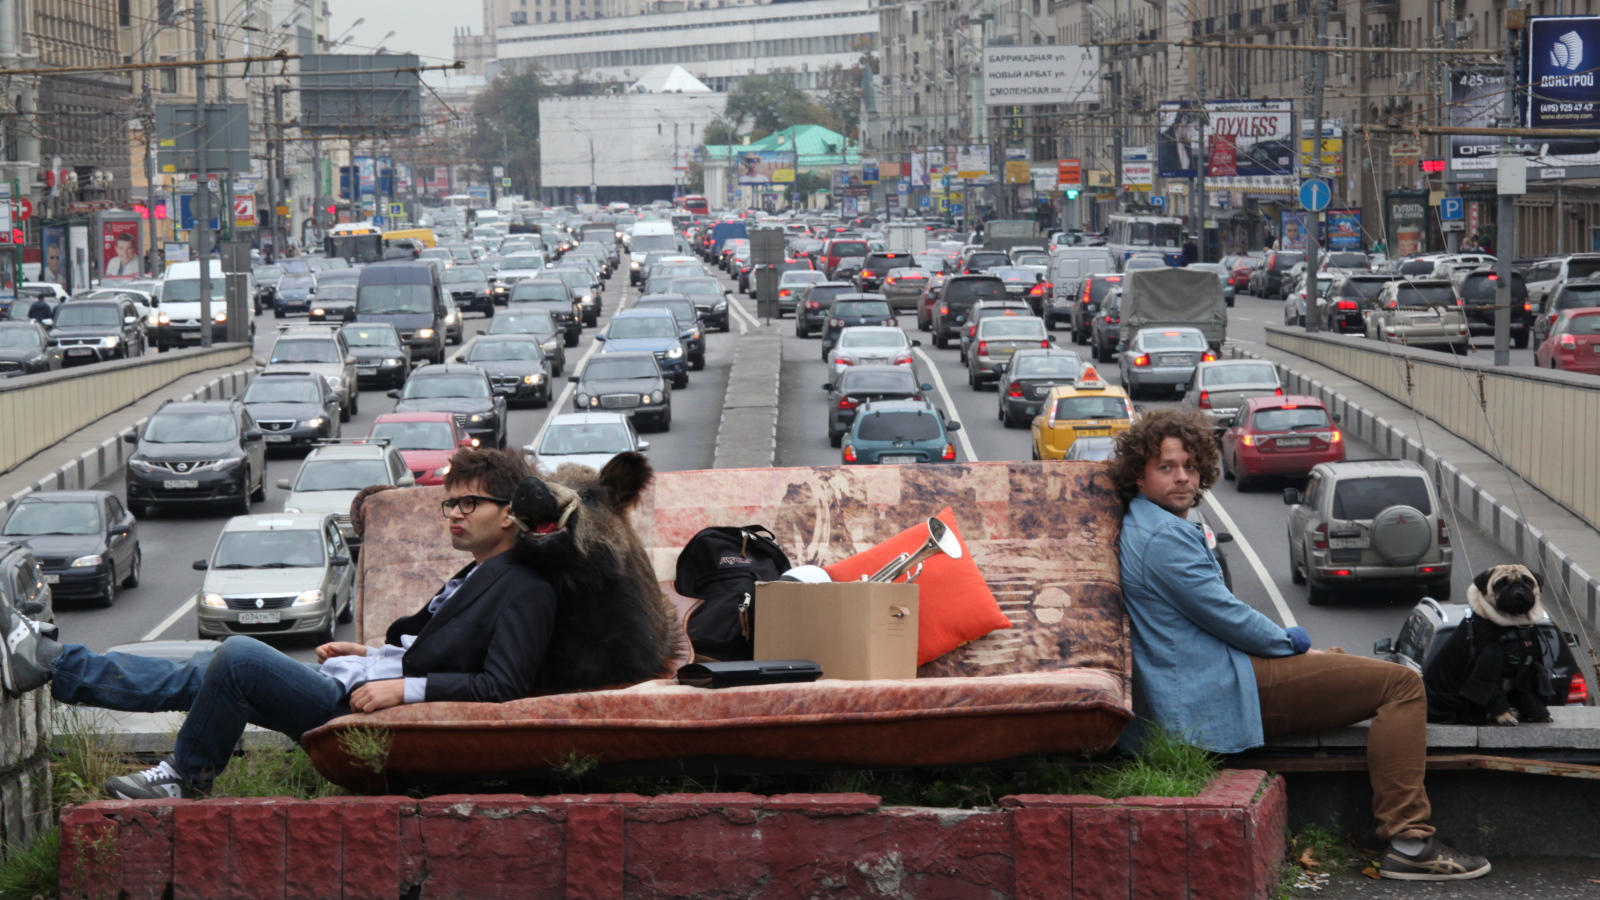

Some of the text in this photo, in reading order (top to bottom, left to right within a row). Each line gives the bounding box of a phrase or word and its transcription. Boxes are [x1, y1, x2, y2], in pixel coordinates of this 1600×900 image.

[989, 54, 1053, 63] БАРРИКАДНАЯ
[989, 70, 1022, 79] НОВЫЙ
[1024, 70, 1053, 78] АРБАТ
[1541, 72, 1594, 87] ДОНСТРОЙ
[990, 87, 1049, 96] СМОЛЕНСКАЯ
[1541, 103, 1594, 113] (495) 925 47 47
[1446, 200, 1459, 218] P
